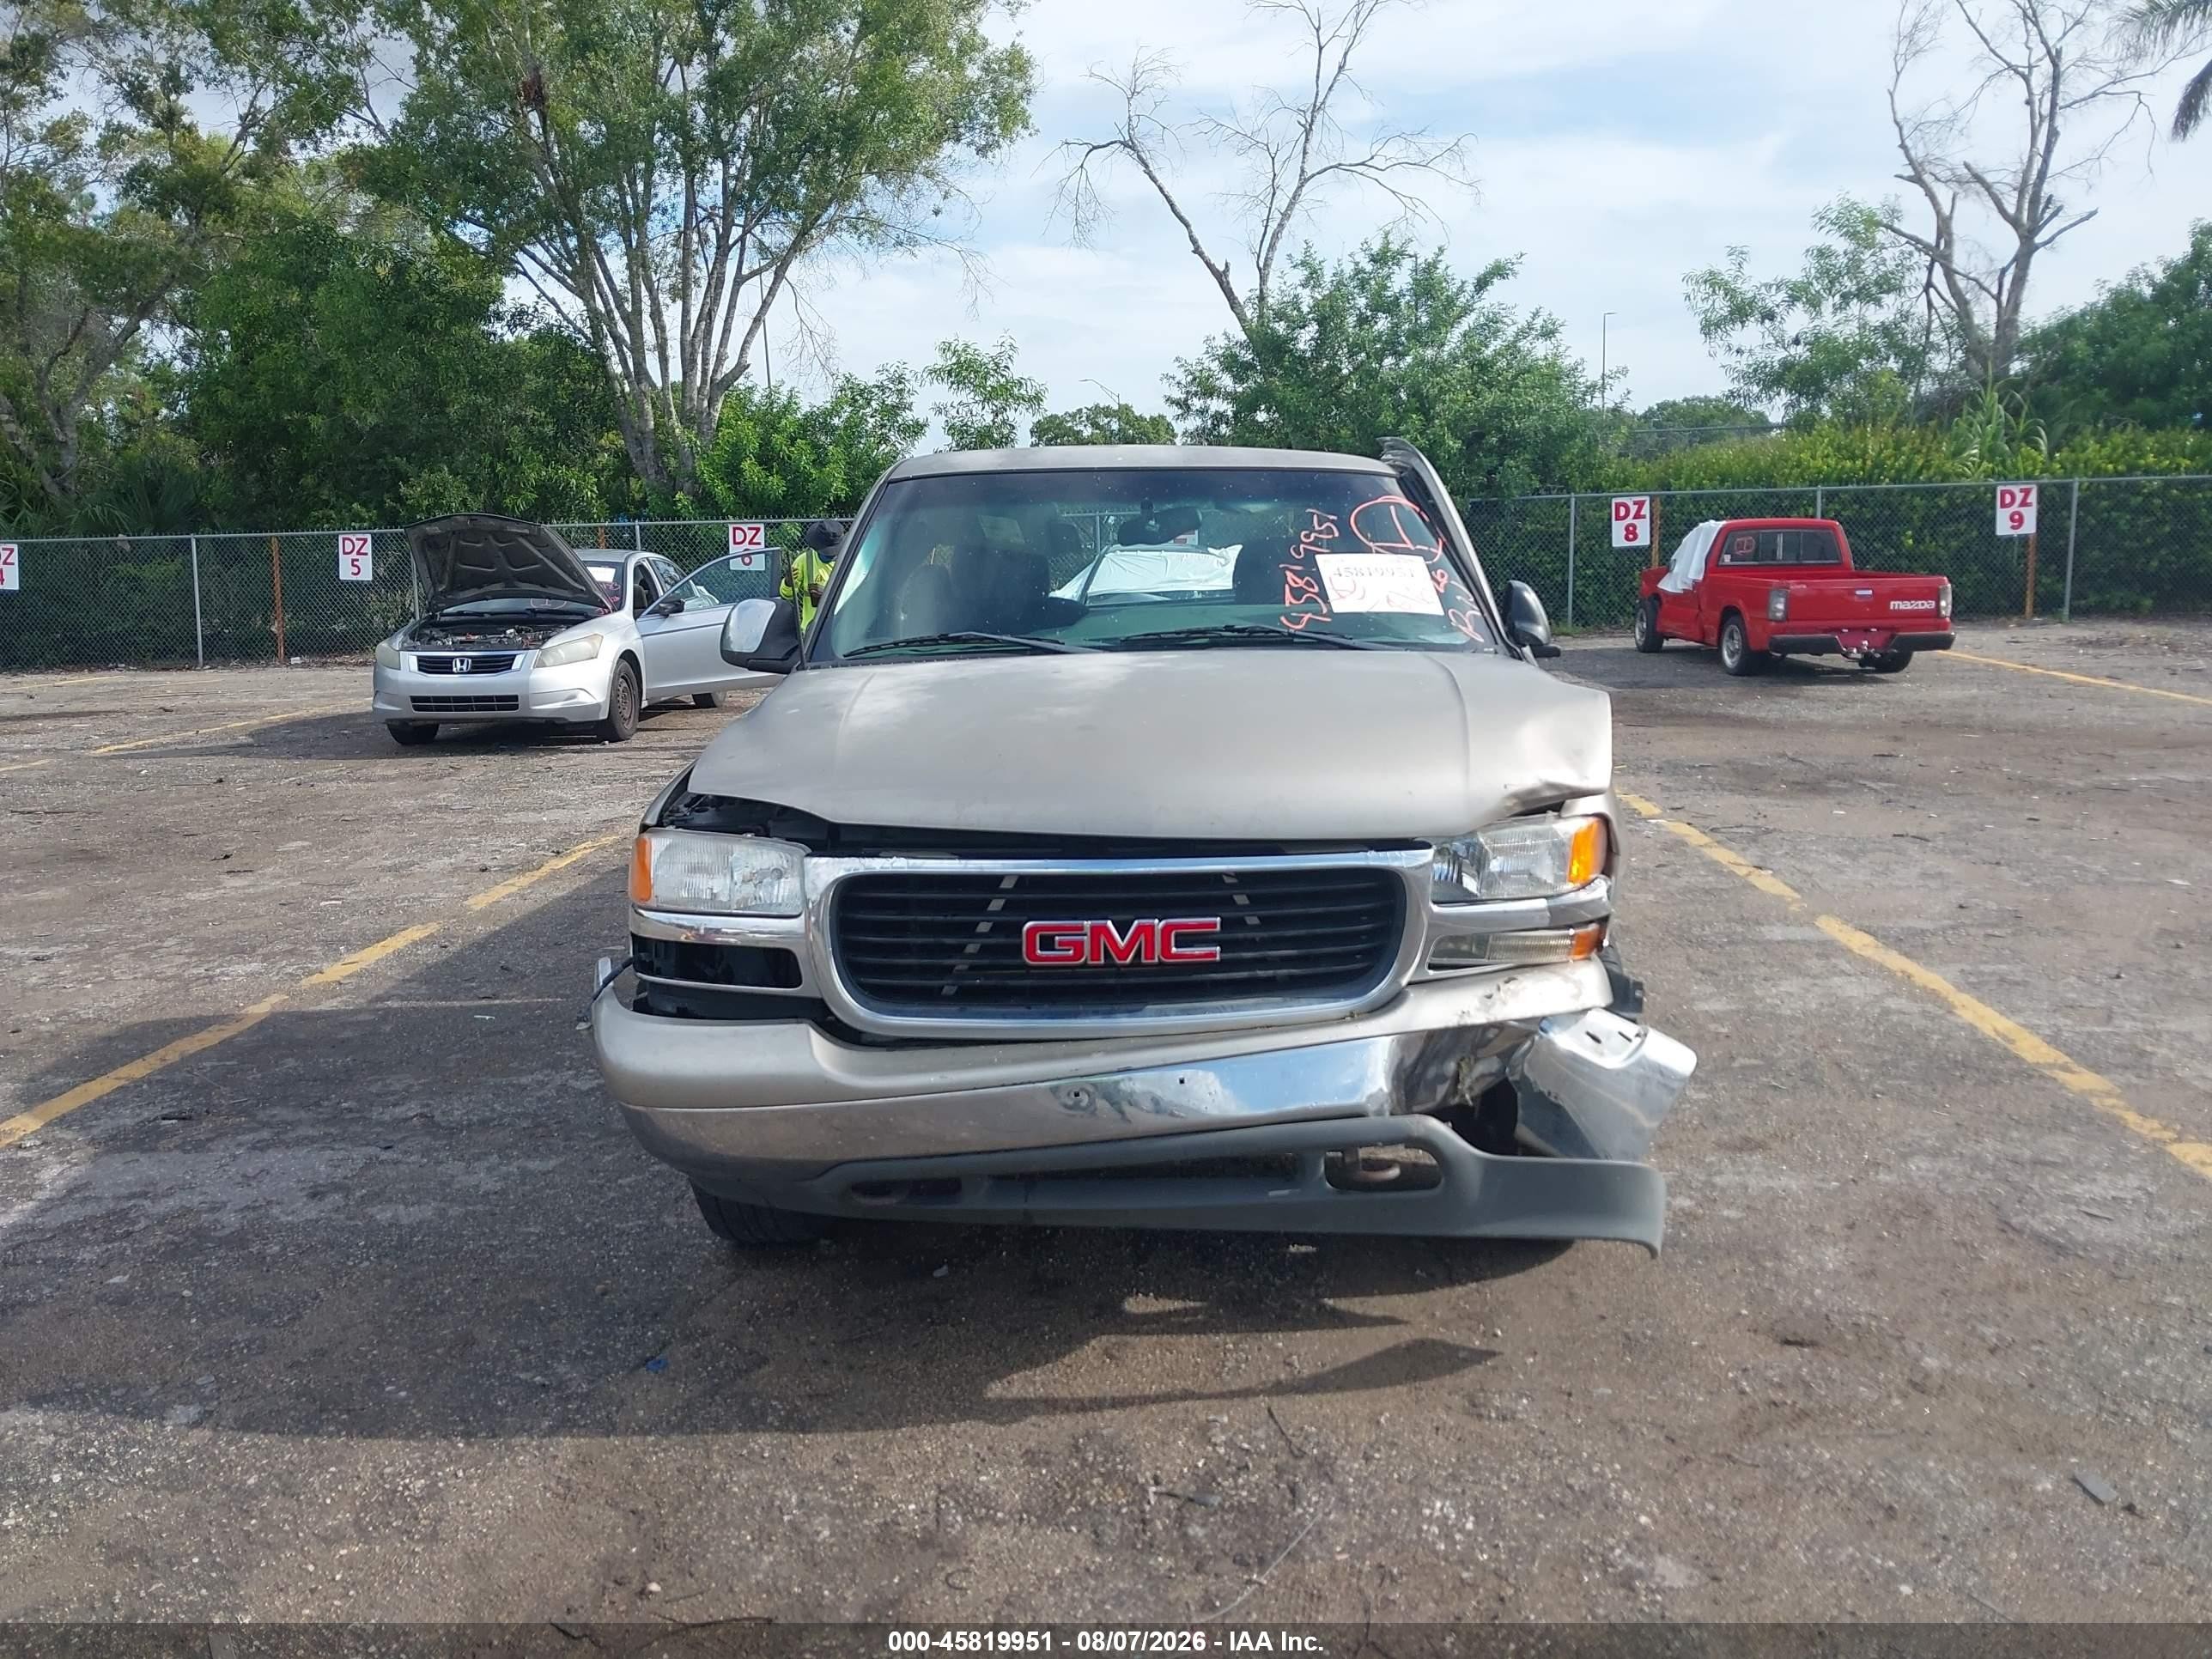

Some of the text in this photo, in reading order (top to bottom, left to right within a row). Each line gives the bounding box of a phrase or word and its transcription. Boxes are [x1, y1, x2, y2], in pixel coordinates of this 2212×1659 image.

[2000, 488, 2033, 508] DZ
[1614, 500, 1647, 521] DZ
[2009, 510, 2025, 530] 9
[732, 526, 762, 545] DZ
[1624, 523, 1638, 542] 8
[0, 548, 15, 565] Z
[342, 538, 368, 556] DZ
[350, 558, 362, 576] 5
[1022, 916, 1222, 966] GMC
